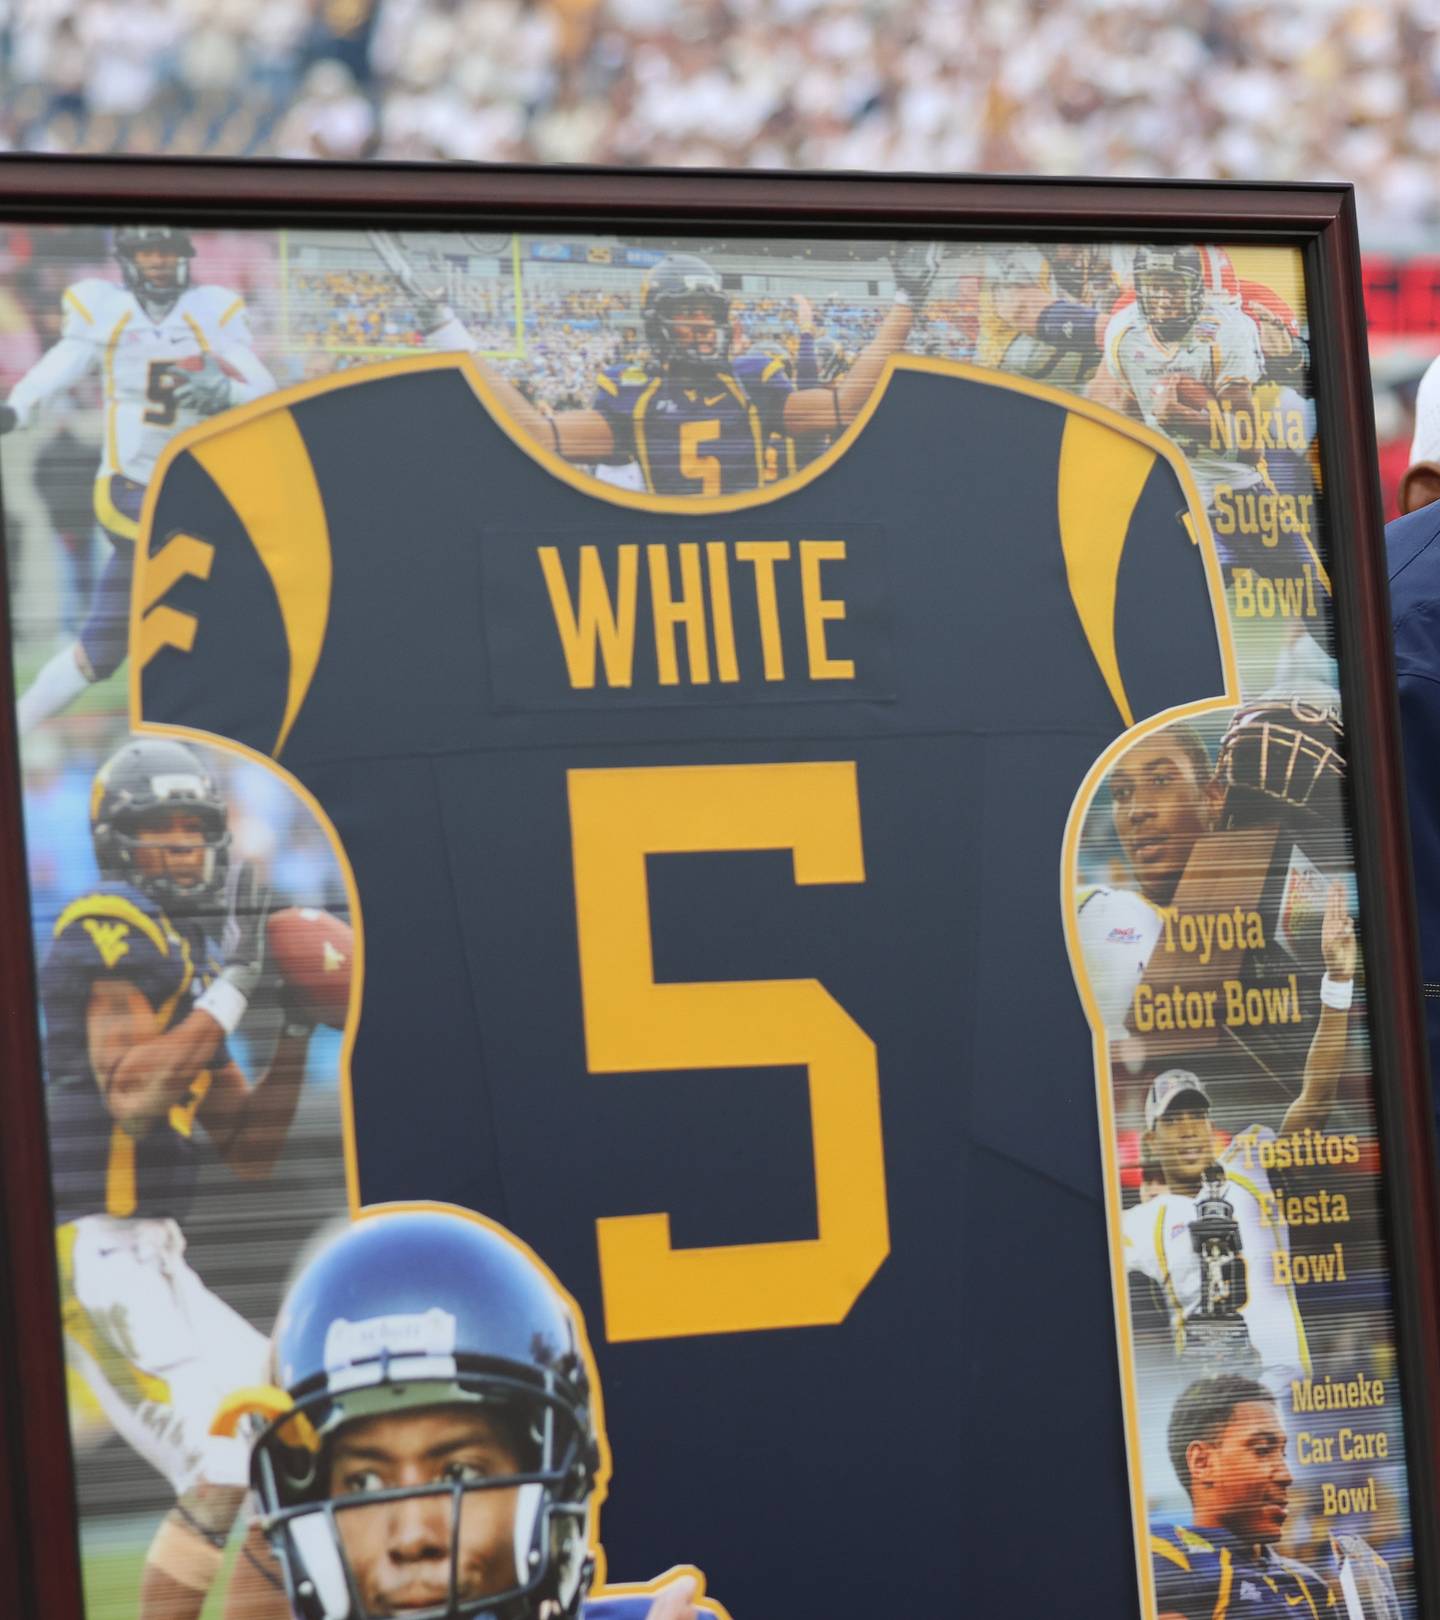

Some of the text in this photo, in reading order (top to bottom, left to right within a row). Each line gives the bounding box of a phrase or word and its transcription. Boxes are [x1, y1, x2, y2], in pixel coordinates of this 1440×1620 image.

[1206, 397, 1305, 450] Nokia
[1213, 484, 1314, 548] Sugar
[537, 540, 855, 689] WHITE
[1231, 564, 1318, 618] Bowl
[1161, 905, 1265, 964] Toyota
[1134, 973, 1301, 1031] Gator Bowl
[566, 761, 890, 1343] 5
[1235, 1128, 1360, 1170] Tostitos
[1259, 1188, 1350, 1227] Fiesta
[1272, 1243, 1347, 1286] Bowl
[1291, 1373, 1385, 1412] Meineke
[1296, 1428, 1389, 1465] Car Care
[1321, 1477, 1378, 1516] Bowl
